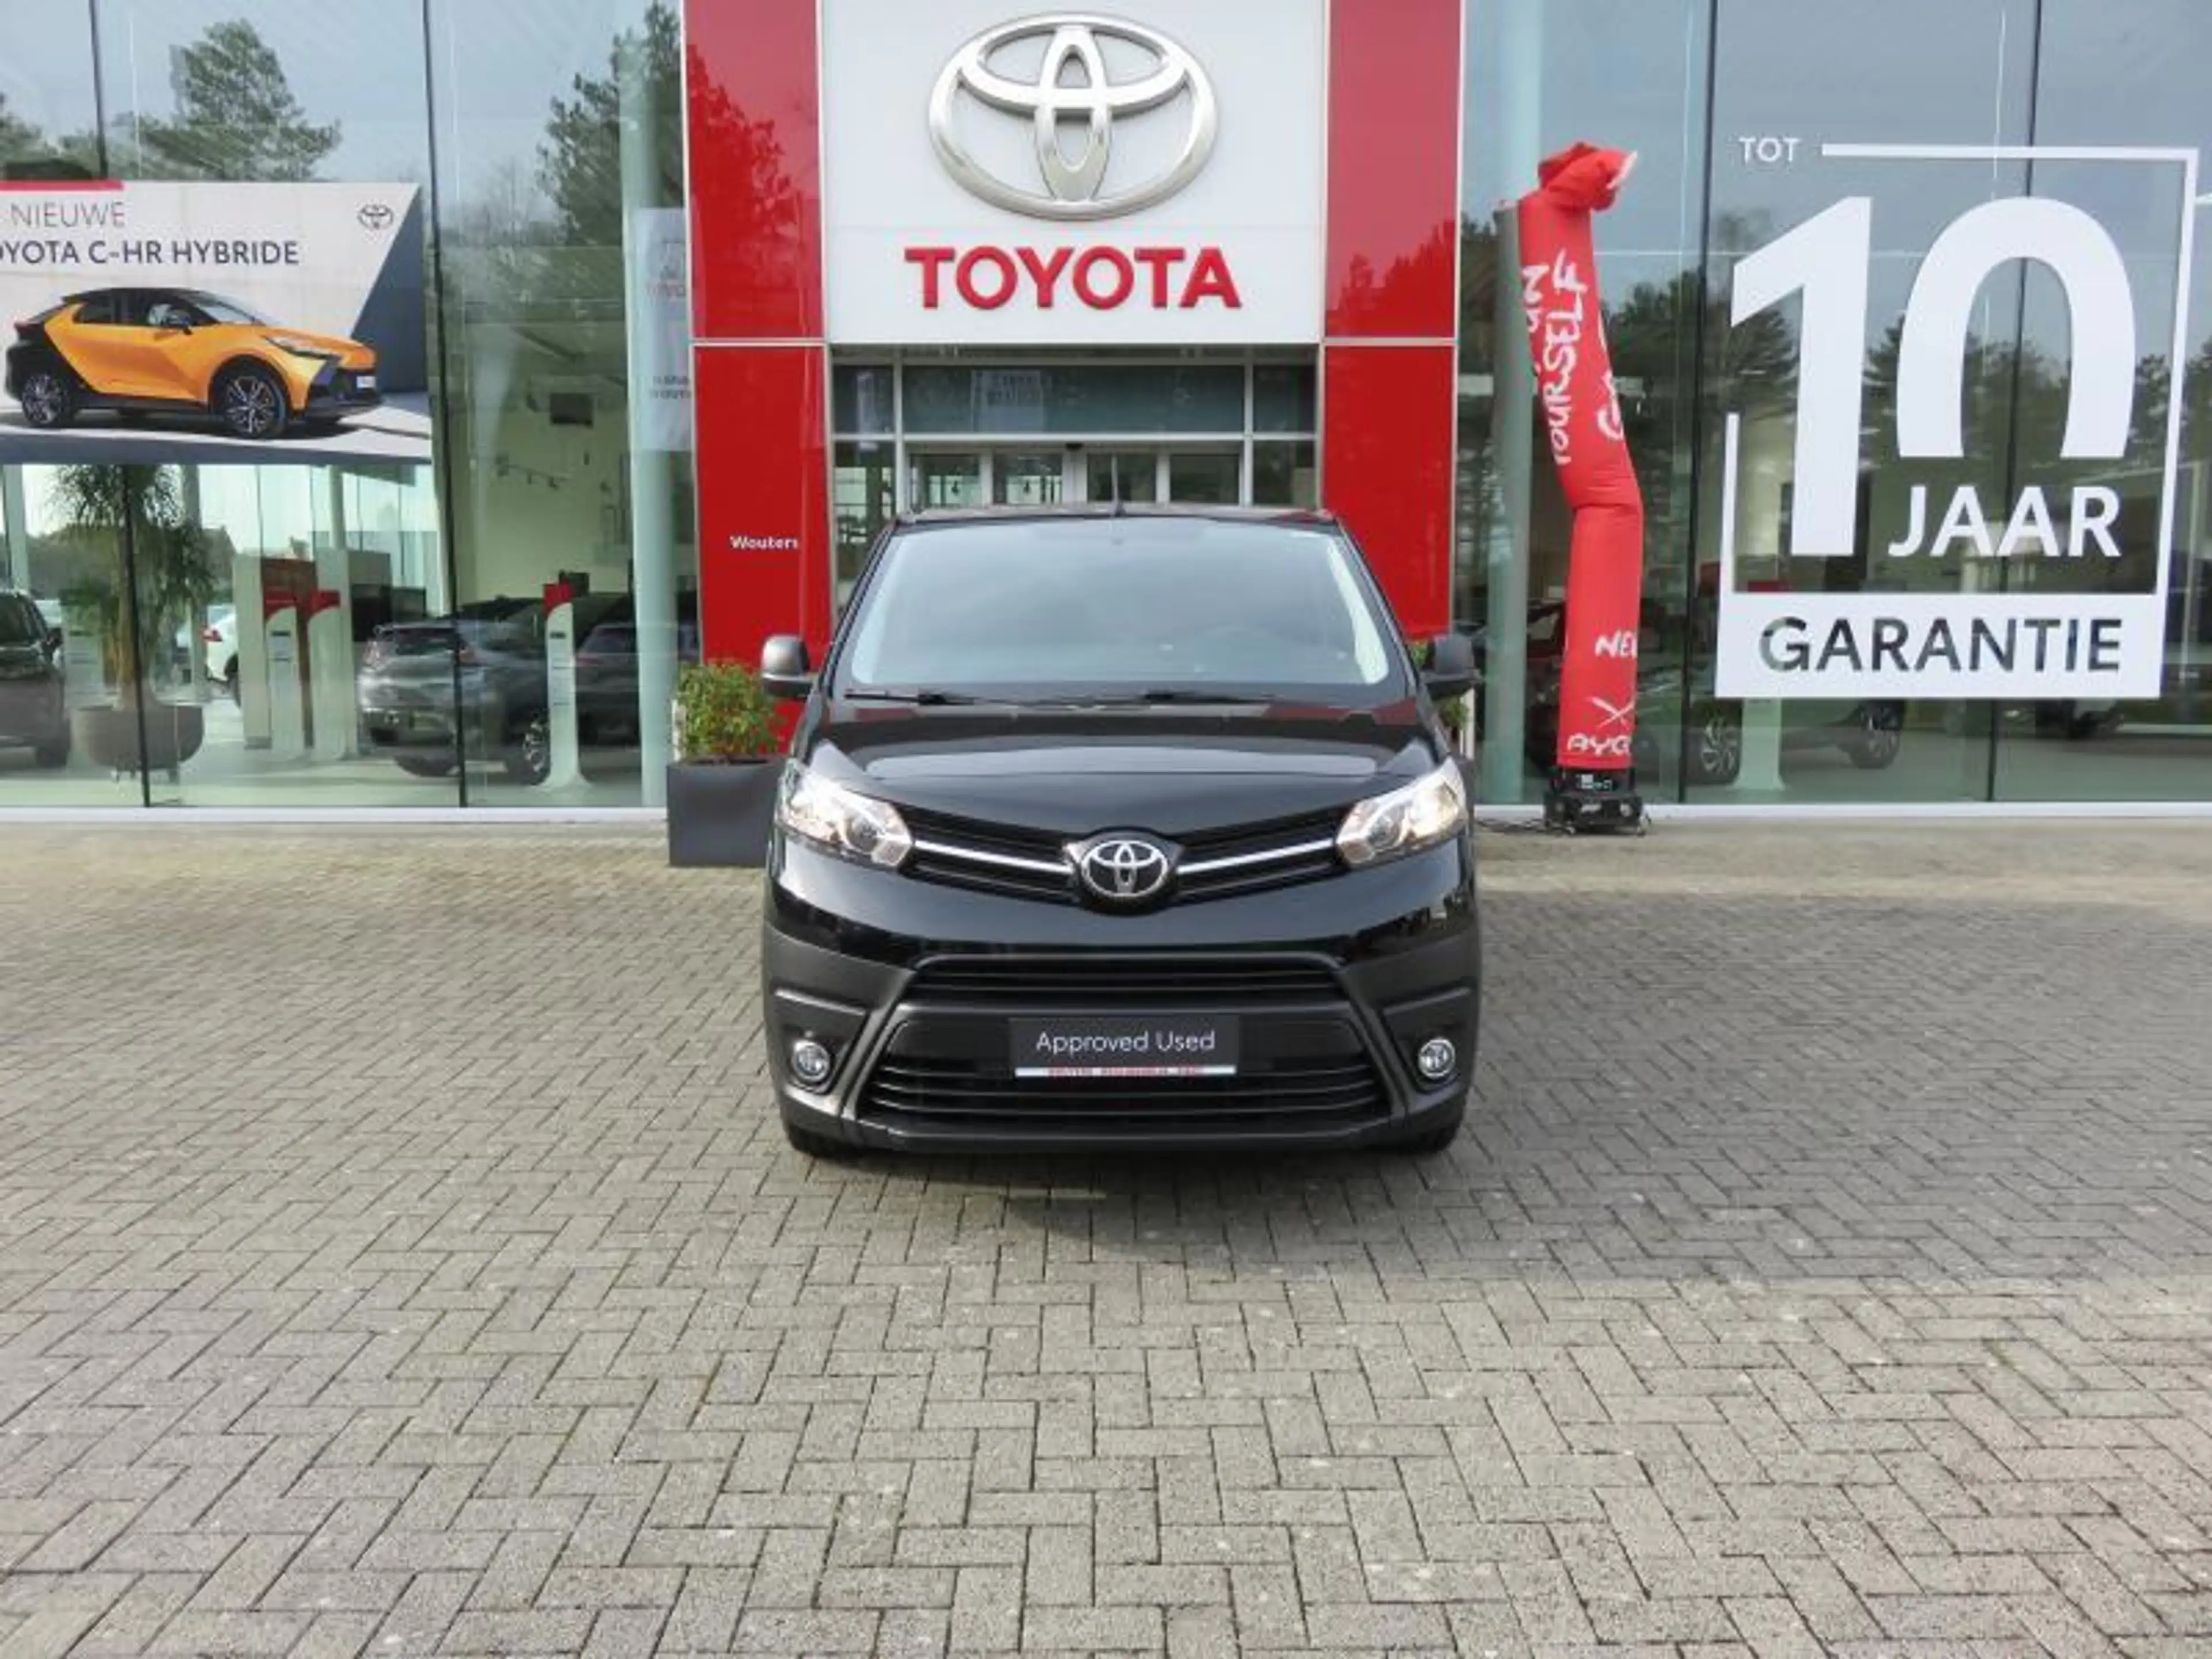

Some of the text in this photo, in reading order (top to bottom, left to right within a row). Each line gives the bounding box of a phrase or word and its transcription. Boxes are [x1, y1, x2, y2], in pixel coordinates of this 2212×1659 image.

[1738, 137, 1801, 163] TOT
[11, 202, 124, 227] NIEUWE
[0, 240, 299, 264] YOTA C-HR HYBRIDE
[904, 245, 1242, 310] TOYOTA
[1731, 196, 2136, 556] 10
[1888, 486, 2122, 557] JAAR
[1758, 617, 2123, 672] GARANTIE
[1036, 1029, 1216, 1056] Approved Used
